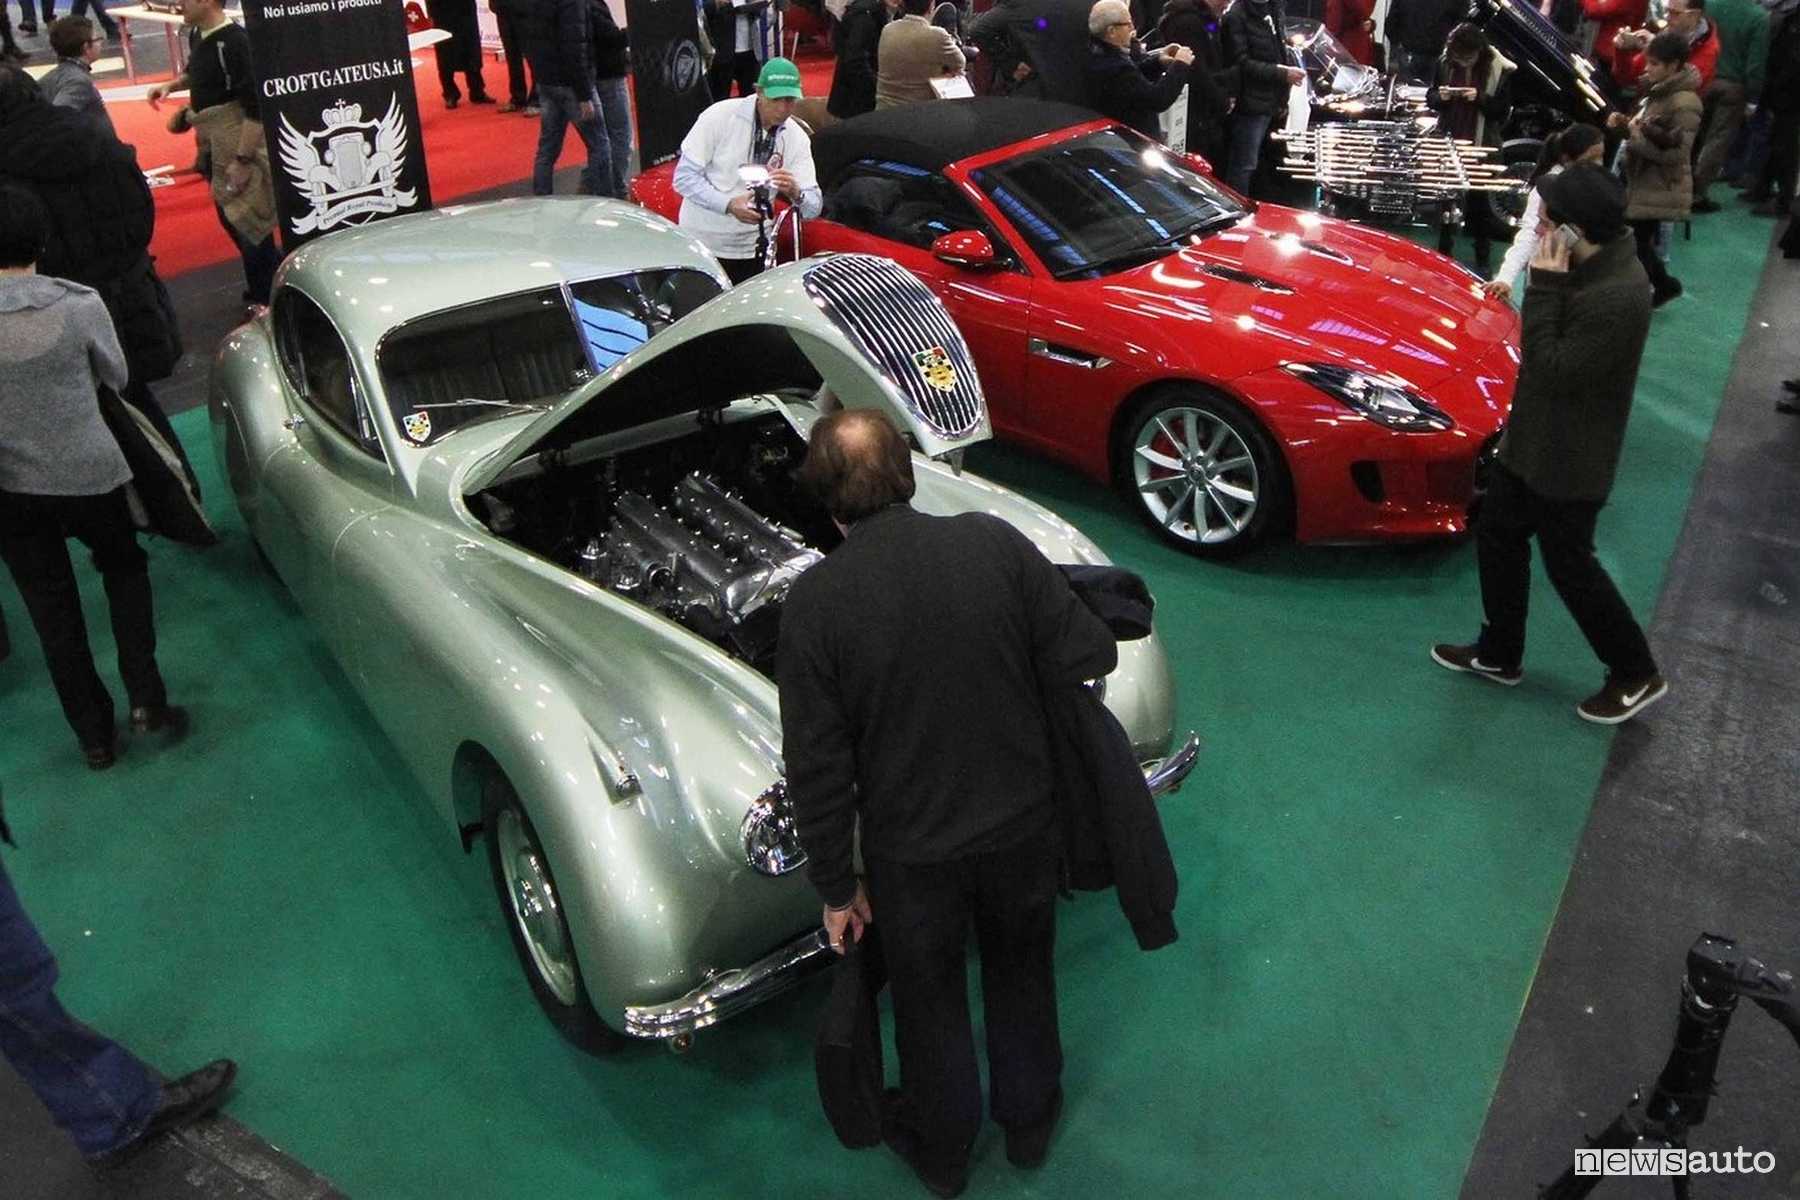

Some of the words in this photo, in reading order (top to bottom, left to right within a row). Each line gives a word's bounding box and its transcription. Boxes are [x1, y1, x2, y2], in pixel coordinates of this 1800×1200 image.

[264, 4, 285, 19] Noi
[287, 2, 329, 16] usiamo
[331, 0, 336, 11] i
[263, 59, 404, 98] CROFTGATEUSA.it
